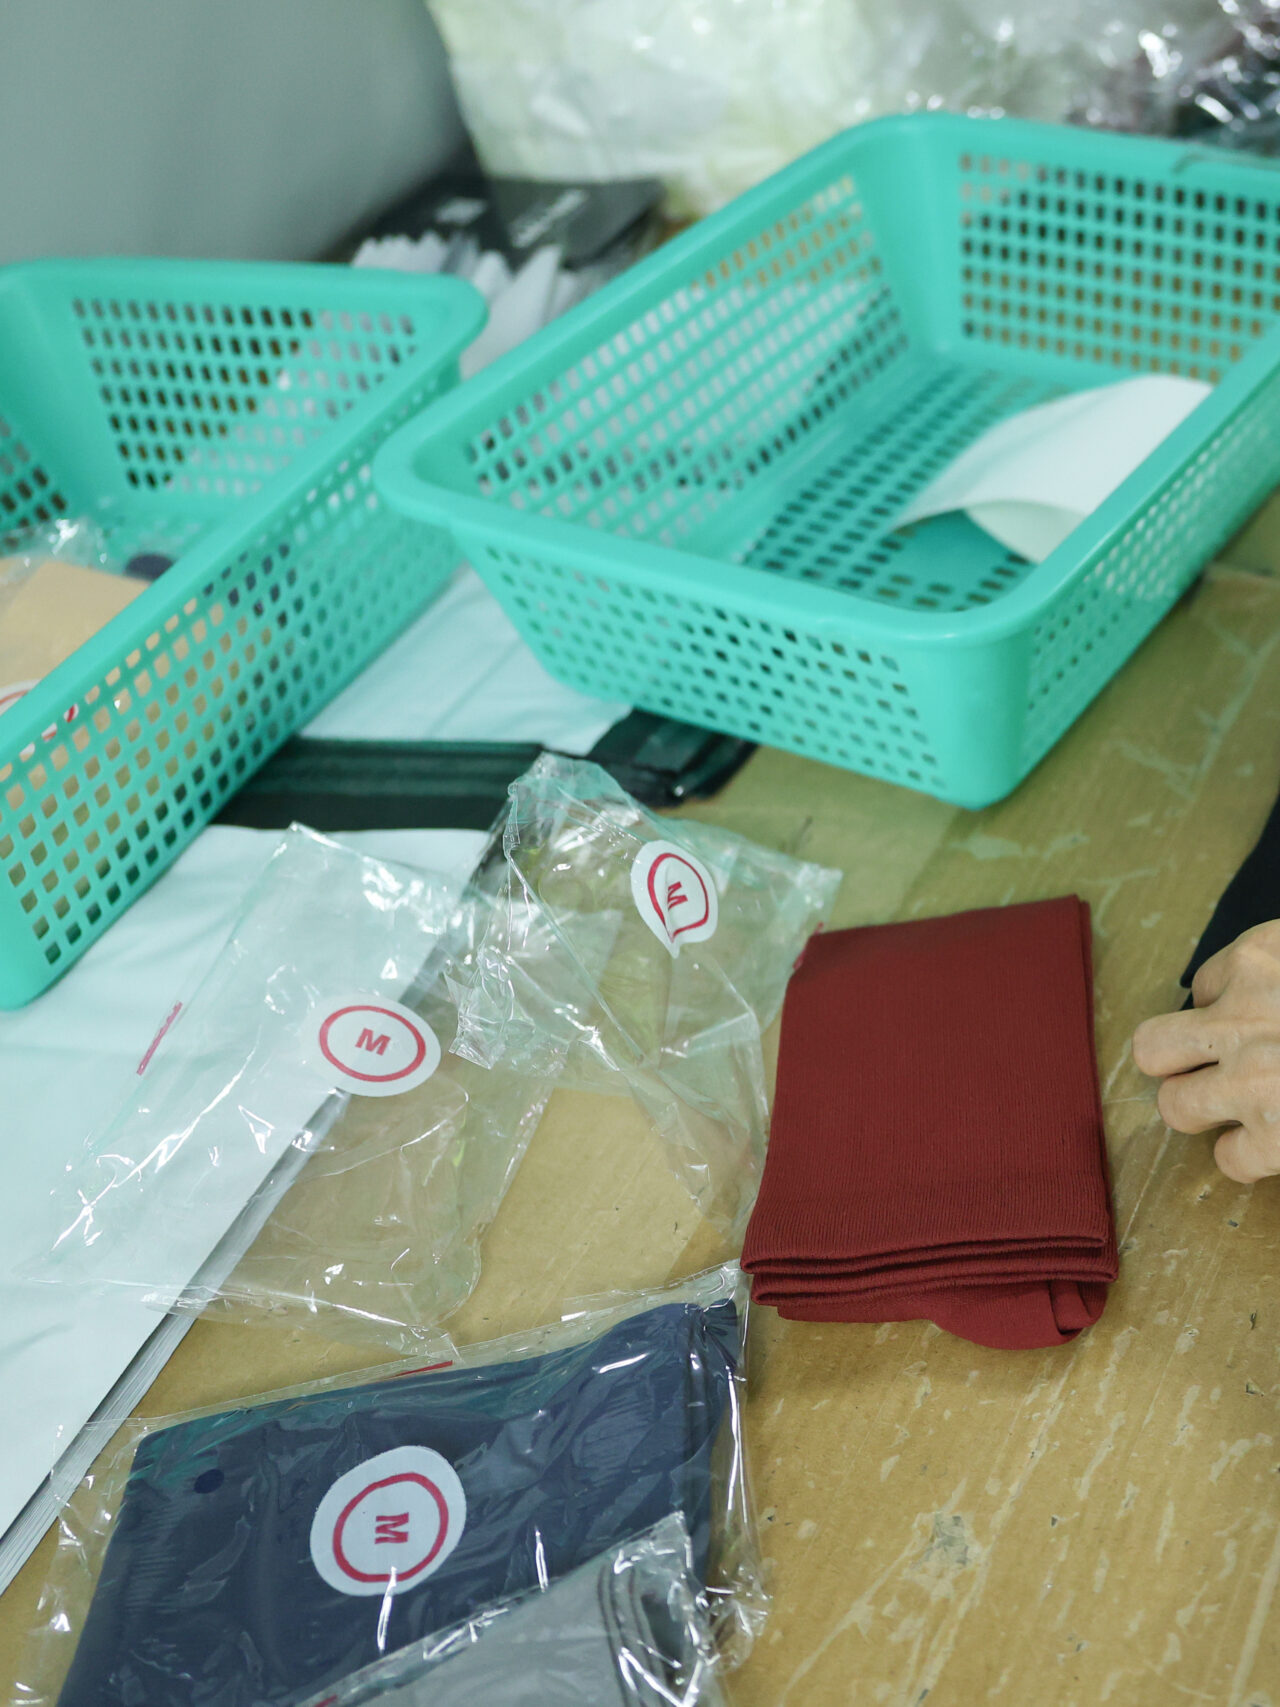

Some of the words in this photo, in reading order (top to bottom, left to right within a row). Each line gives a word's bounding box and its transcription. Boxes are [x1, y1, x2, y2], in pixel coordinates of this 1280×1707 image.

[667, 882, 688, 910] M
[355, 1028, 391, 1056] M
[375, 1512, 409, 1544] M
